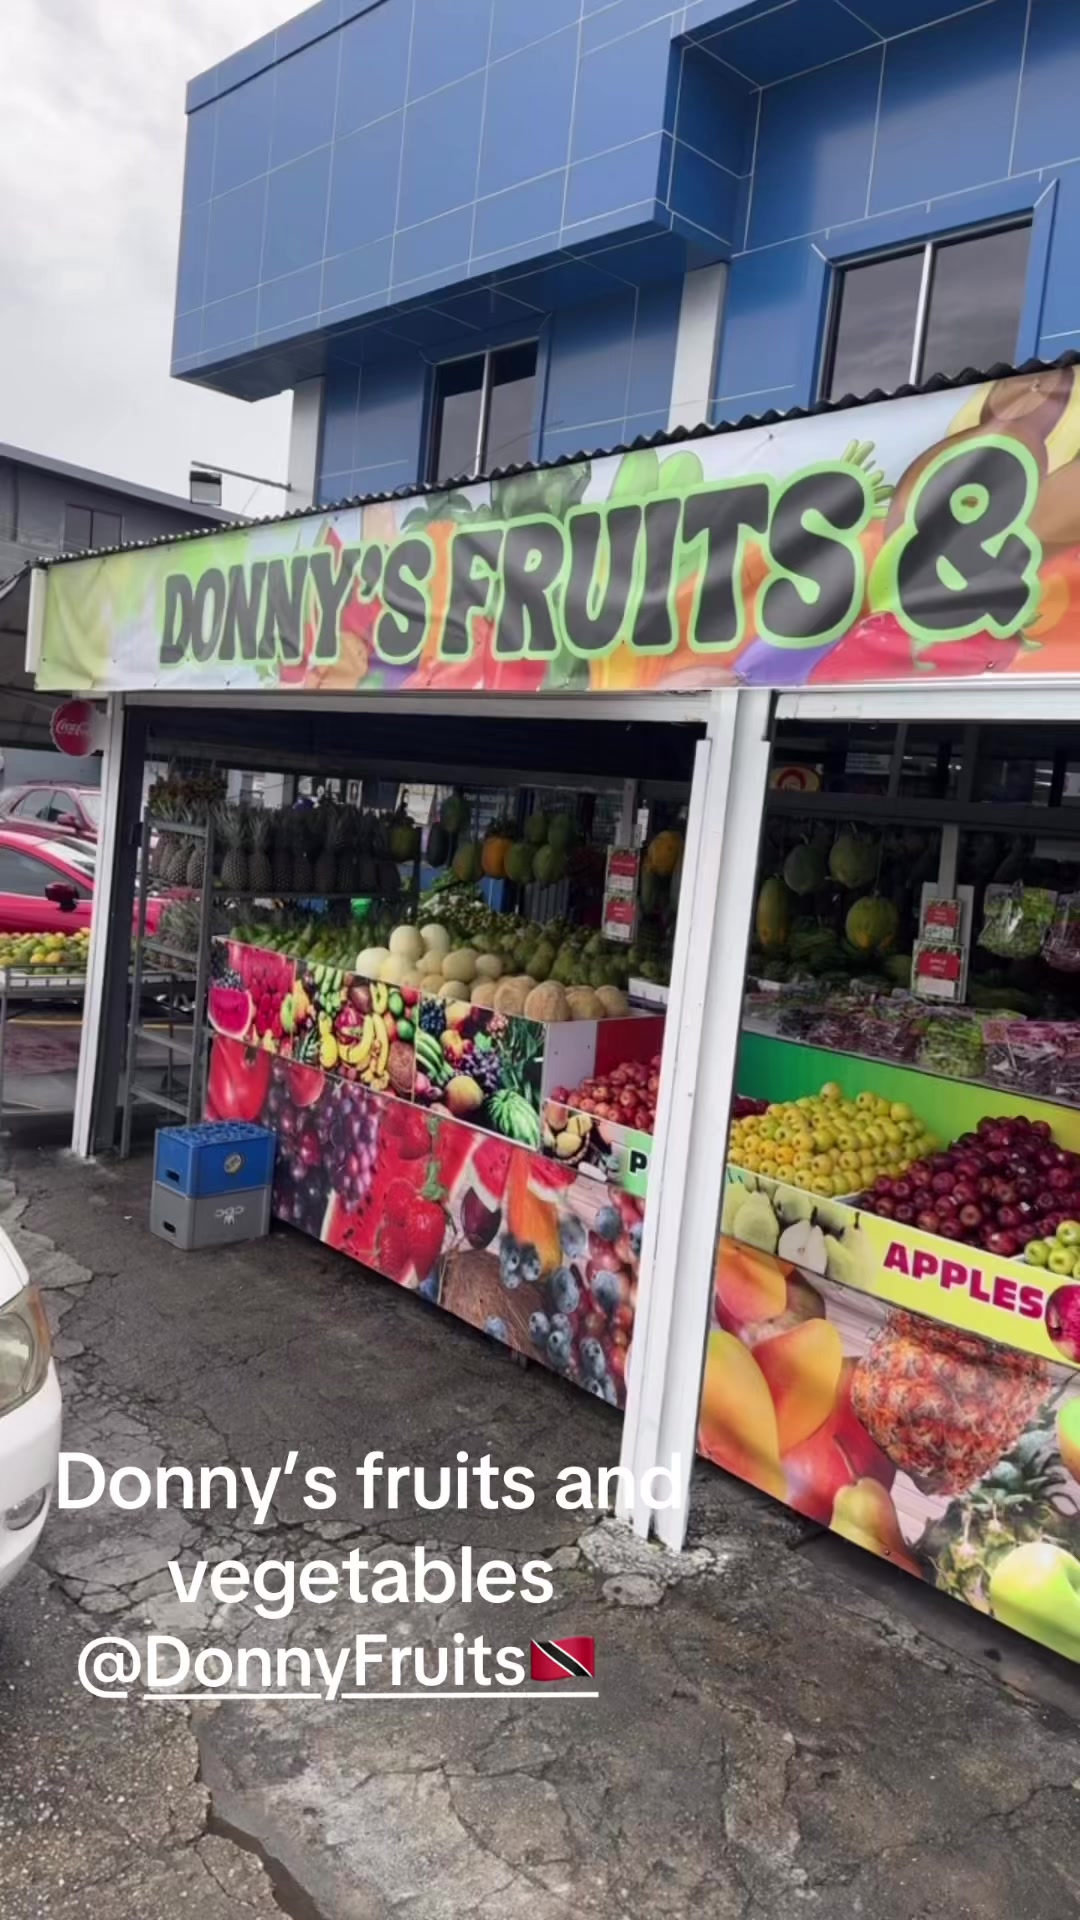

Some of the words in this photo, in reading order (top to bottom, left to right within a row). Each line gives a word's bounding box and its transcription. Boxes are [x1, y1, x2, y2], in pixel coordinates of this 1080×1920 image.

[159, 539, 433, 664] DONNY'S
[440, 471, 865, 656] FRUITS
[897, 446, 1031, 631] &
[882, 1241, 1044, 1320] APPLES
